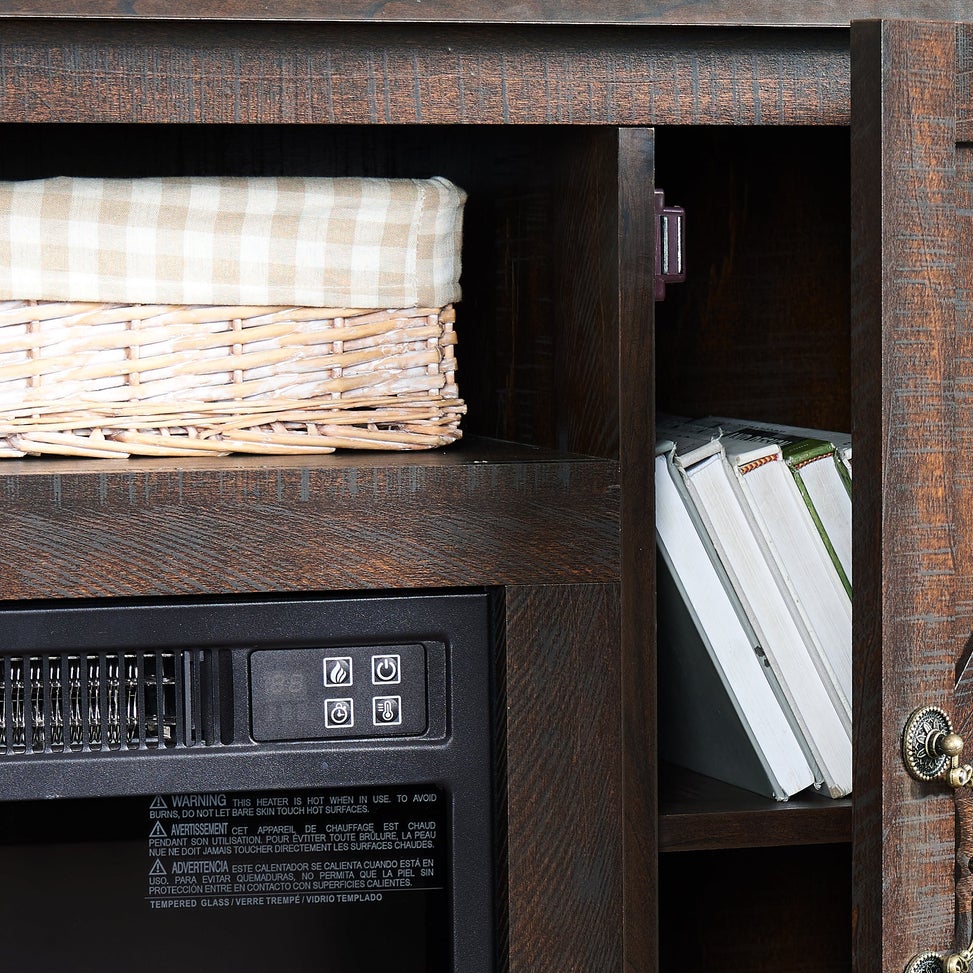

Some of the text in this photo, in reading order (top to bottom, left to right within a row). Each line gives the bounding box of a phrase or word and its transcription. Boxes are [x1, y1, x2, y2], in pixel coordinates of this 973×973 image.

[172, 794, 226, 807] WARNING
[257, 798, 288, 806] HEATER
[373, 795, 391, 803] USE.
[413, 794, 437, 802] AVOID
[150, 810, 180, 819] BURNS,
[197, 809, 213, 817] NOT
[215, 809, 230, 817] LET
[232, 808, 254, 816] BARE
[278, 807, 304, 815] TOUCH
[307, 806, 323, 814] HOT
[325, 805, 369, 813] SURFACES.
[171, 823, 228, 836] AVERTISSEMENT
[258, 826, 296, 834] APPAREIL
[326, 823, 374, 832] CHAUFFAGE
[408, 822, 436, 830] CHAUD
[149, 838, 188, 846] PENDANT
[212, 836, 262, 845] UTILISATION.
[330, 833, 356, 841] TOUTE
[414, 831, 436, 839] PEAU
[149, 848, 166, 856] NUE
[182, 847, 200, 855] DOIT
[203, 846, 231, 855] JAMAIS
[235, 846, 272, 854] TOUCHER
[275, 843, 332, 853] DIRECTEMENT
[334, 843, 348, 851] LES
[351, 842, 392, 850] SURFACES
[394, 841, 434, 849] CHAUDES.
[172, 861, 228, 874] ADVERTENCIA
[232, 865, 253, 873] ESTE
[255, 862, 309, 872] CALENTADOR
[311, 862, 322, 870] SE
[324, 861, 362, 870] CALIENTA
[364, 860, 398, 869] CUANDO
[149, 877, 168, 885] USO.
[175, 876, 197, 884] PARA
[202, 875, 230, 883] EVITAR
[237, 873, 295, 882] QUEMADURAS,
[320, 871, 354, 880] PERMITA
[205, 884, 232, 892] ENTRE
[247, 882, 291, 891] CONTACTO
[313, 880, 365, 889] SUPERFICIES
[367, 879, 412, 888] CALIENTES.
[150, 900, 196, 908] TEMPERED
[306, 895, 335, 903] VIDRIO
[337, 893, 382, 902] TEMPLADO
